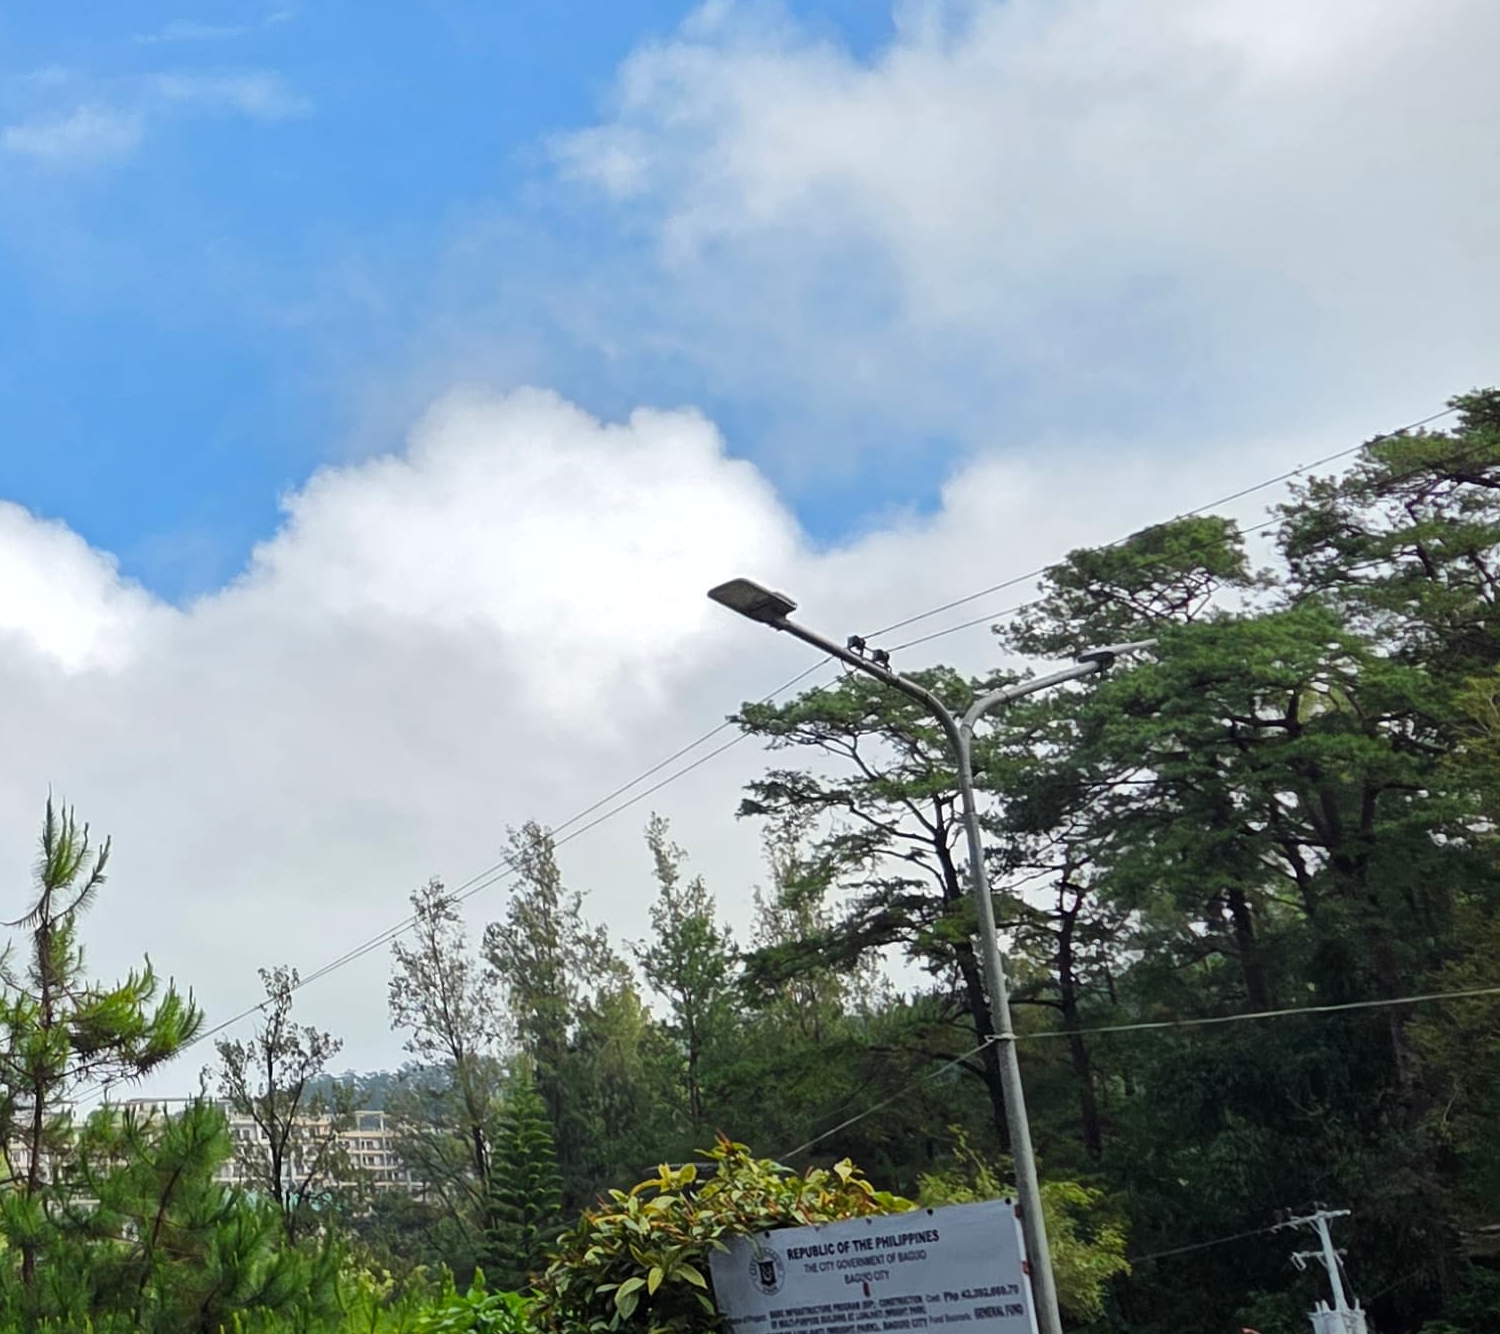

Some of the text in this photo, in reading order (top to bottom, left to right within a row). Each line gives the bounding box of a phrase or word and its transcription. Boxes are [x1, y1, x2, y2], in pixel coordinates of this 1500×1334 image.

[787, 1229, 939, 1260] REPUBLIC OF THE PHILIPPINES
[803, 1249, 927, 1273] THE CITY GOVERNMENT OF BAGUIO
[873, 1270, 889, 1281] CITY
